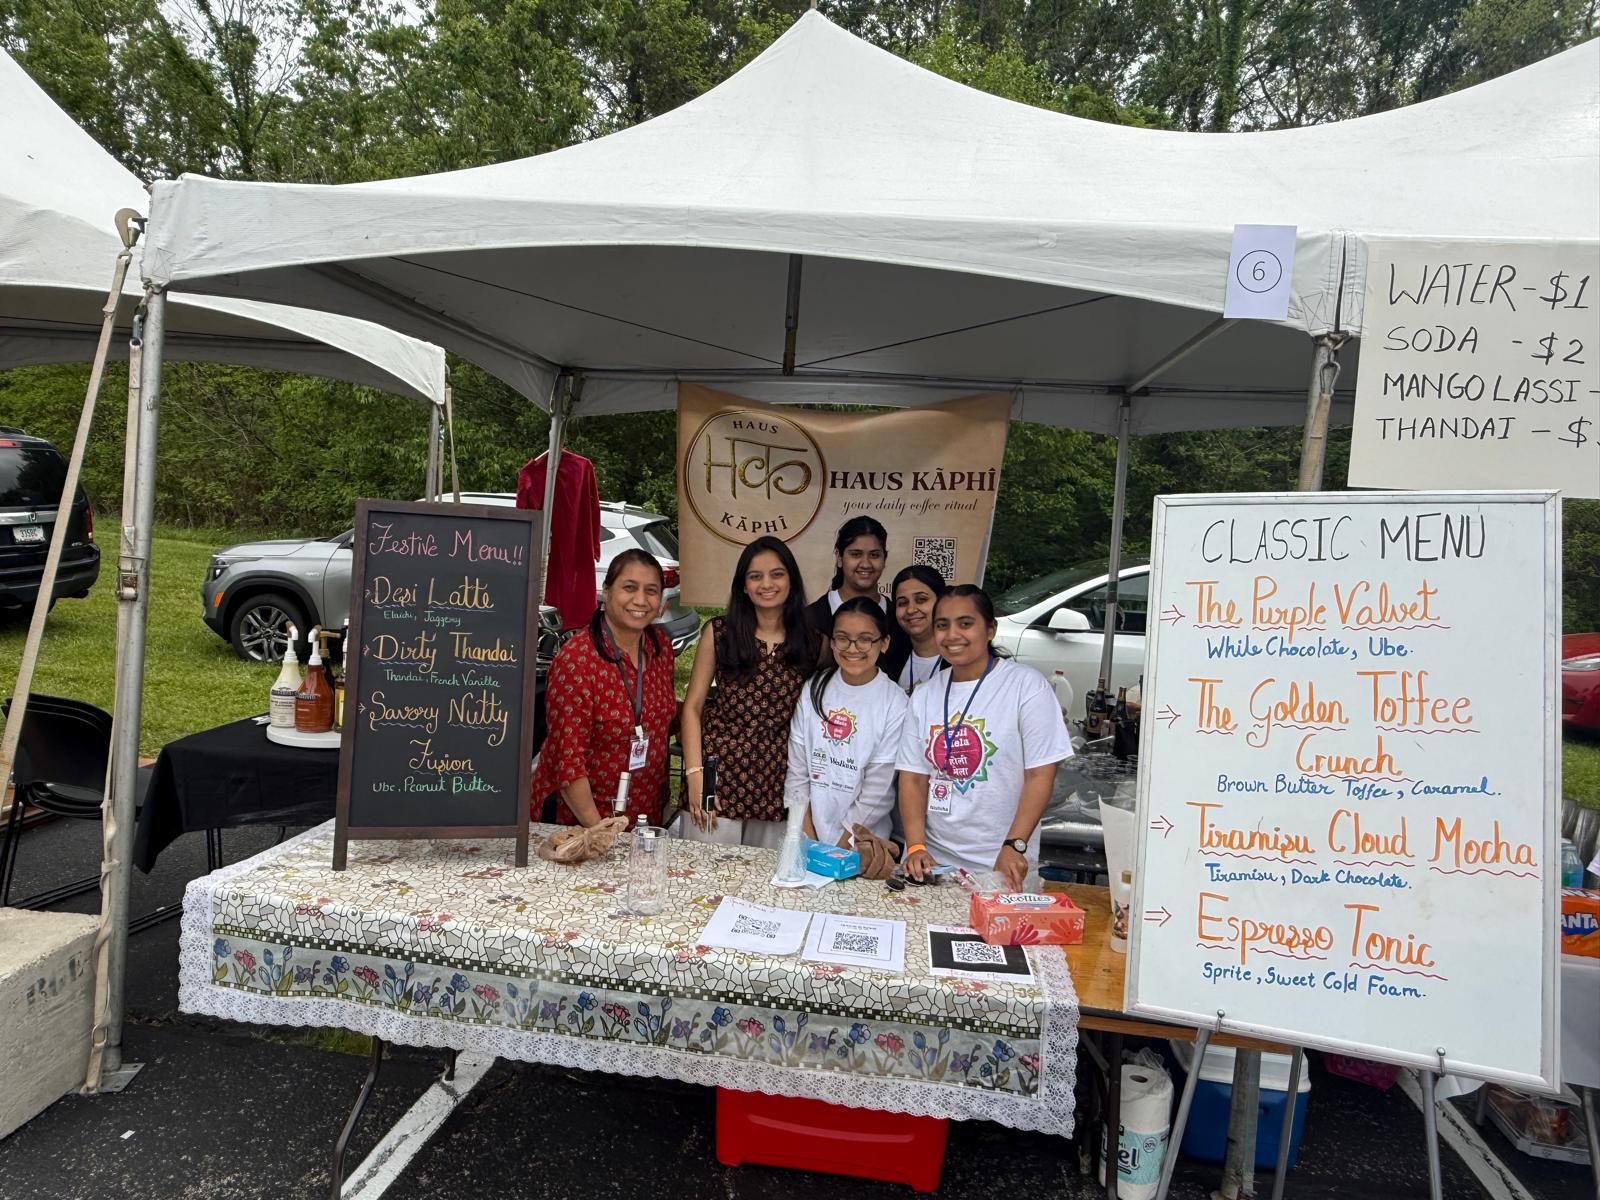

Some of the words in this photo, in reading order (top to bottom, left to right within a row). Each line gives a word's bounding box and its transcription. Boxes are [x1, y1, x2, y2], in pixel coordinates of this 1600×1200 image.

[1252, 261, 1266, 281] 6
[1383, 325, 1478, 354] SODA
[1383, 372, 1485, 401] MANGO
[1492, 375, 1582, 404] LASSI
[732, 420, 779, 434] HAUS
[1376, 416, 1516, 441] THANDAI
[829, 471, 903, 491] HAUS
[841, 500, 872, 515] your
[875, 498, 907, 516] daily
[910, 498, 941, 515] coffee
[944, 498, 978, 511] ritual
[369, 522, 439, 557] Festive
[1201, 515, 1352, 564] CLASSIC
[1380, 512, 1485, 562] MENU
[371, 576, 418, 607] Desi
[428, 575, 494, 609] Latte
[1185, 580, 1243, 625] The
[1252, 575, 1327, 644] Purple
[372, 630, 437, 674] Dirty
[449, 631, 518, 663] Thandai
[1265, 635, 1358, 660] Chocolate,
[461, 669, 501, 687] Vanilla
[369, 691, 439, 734] Savory
[448, 688, 508, 746] Nutty
[1188, 677, 1239, 731] The
[1246, 678, 1349, 748] Golden
[1356, 670, 1473, 728] Toffee
[409, 738, 475, 775] Fusion
[1295, 733, 1403, 776] Crunch
[404, 776, 447, 793] Peanut
[1217, 774, 1268, 793] Brown
[1275, 774, 1335, 795] Butter
[1185, 801, 1316, 858] Tiramisu
[1328, 809, 1415, 858] Cloud
[1427, 816, 1538, 868] Mocha
[1291, 868, 1331, 884] Dark
[1197, 892, 1334, 965] Espresso
[1343, 903, 1436, 967] Tonic
[1561, 912, 1599, 929] ANTA
[1265, 967, 1316, 988] Sweet
[1323, 971, 1358, 993] Cold
